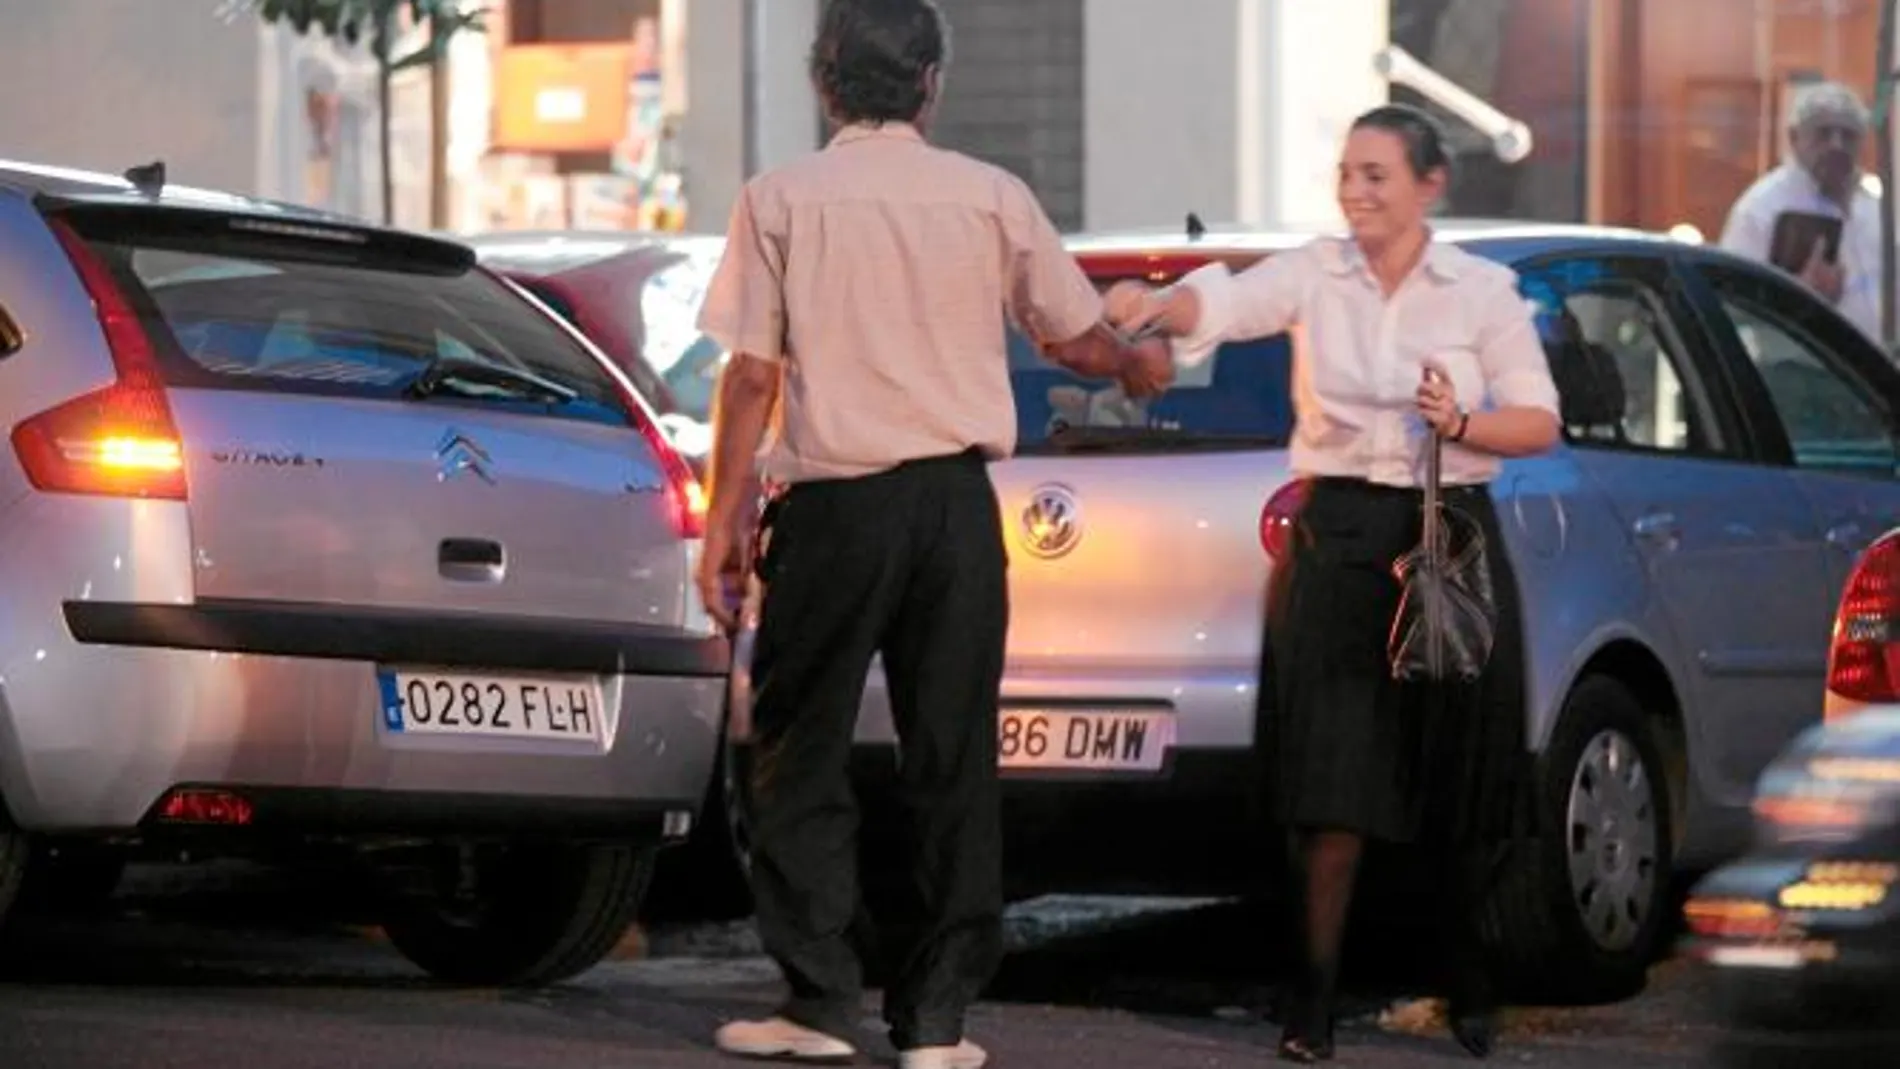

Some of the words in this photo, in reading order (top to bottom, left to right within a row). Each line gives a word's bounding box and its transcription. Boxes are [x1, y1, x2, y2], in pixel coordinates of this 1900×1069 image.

[406, 678, 511, 729] 0282
[519, 683, 592, 734] FLH
[1064, 716, 1147, 761] DMW
